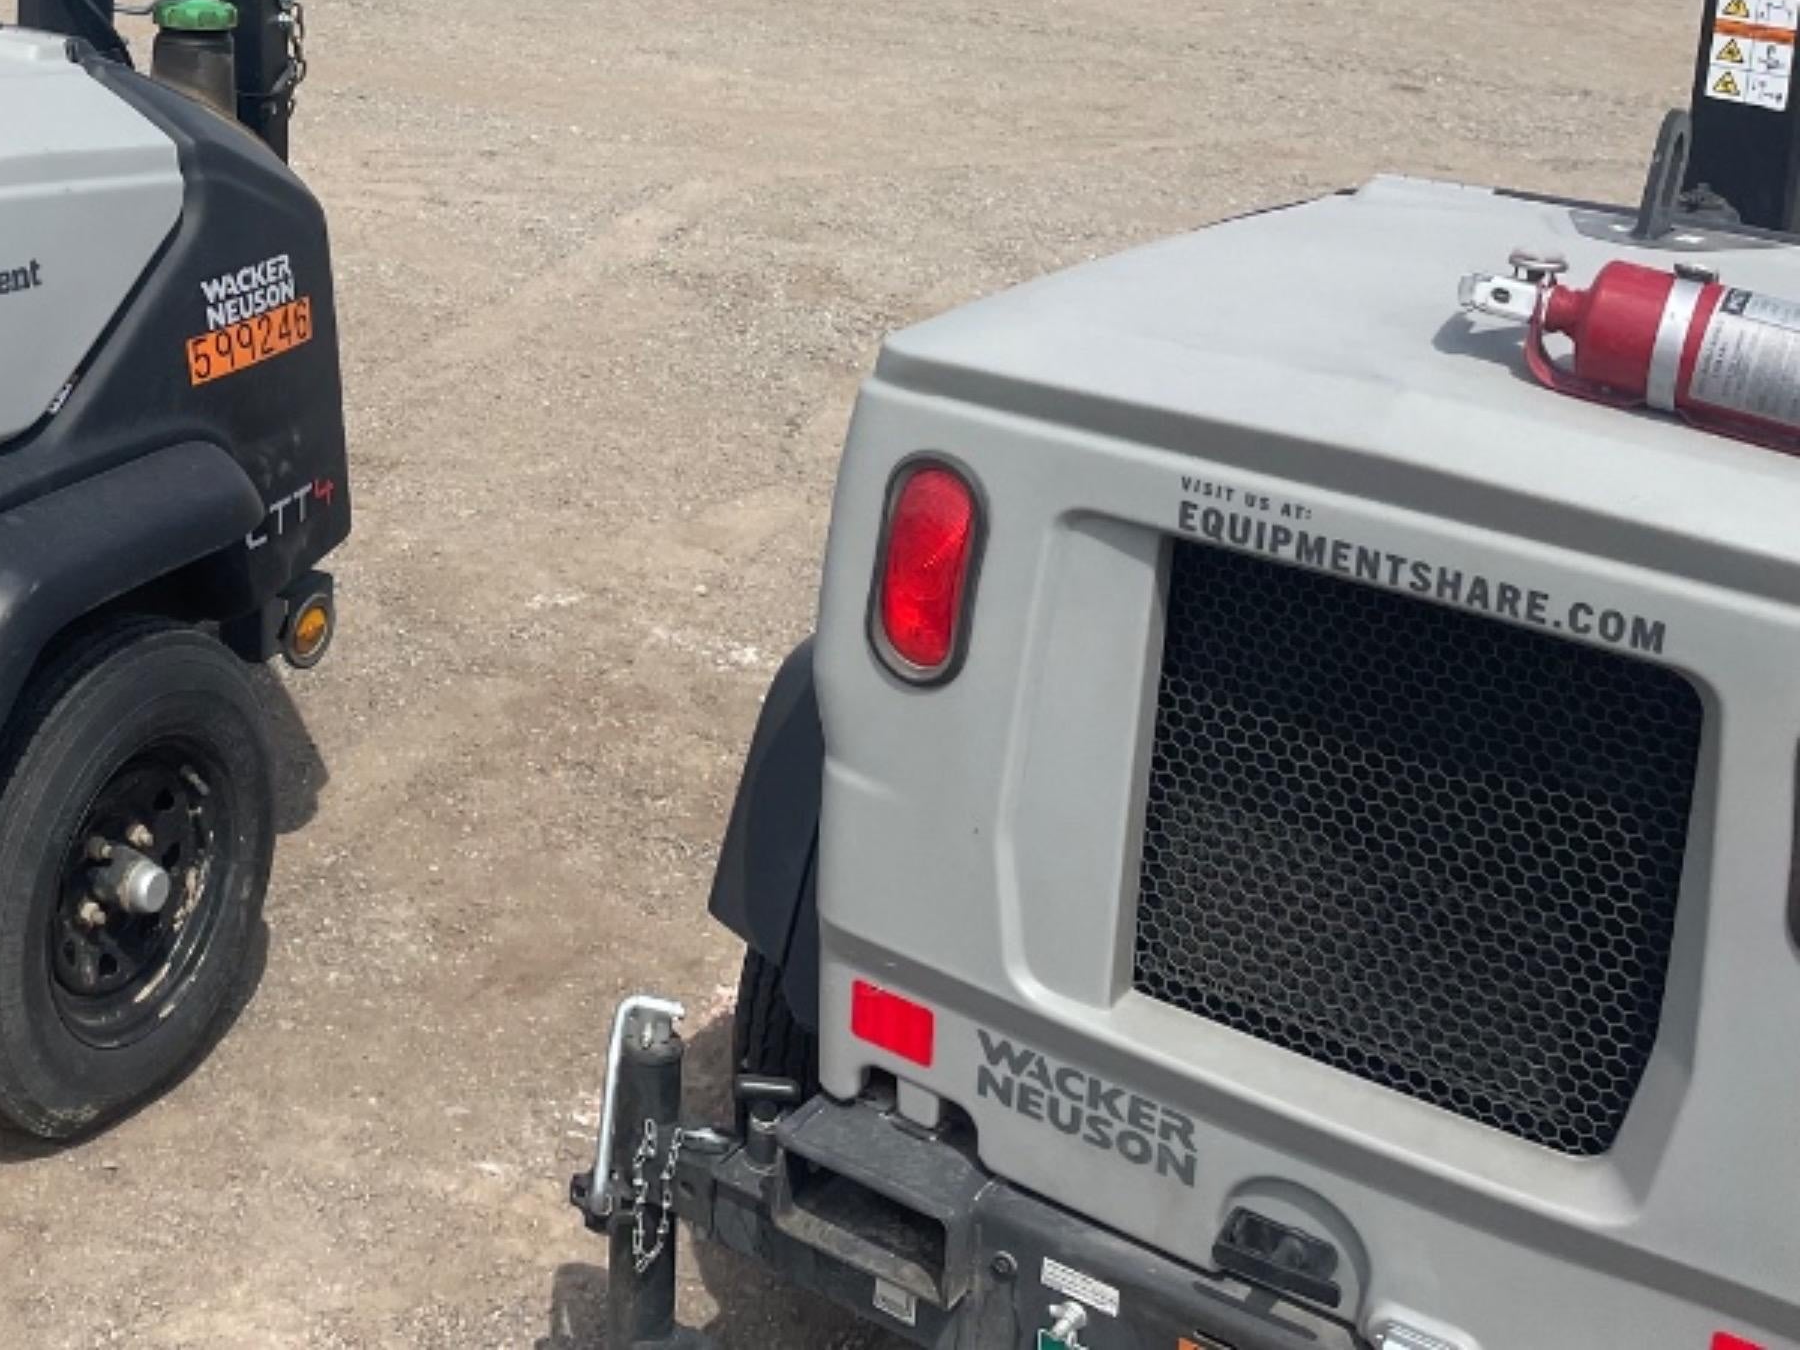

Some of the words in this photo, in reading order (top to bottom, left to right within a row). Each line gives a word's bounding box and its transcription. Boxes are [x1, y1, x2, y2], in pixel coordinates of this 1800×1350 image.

[200, 253, 294, 303] WACKER
[206, 276, 295, 330] NEUSON
[191, 298, 308, 379] 599246
[1180, 475, 1235, 503] VISIT
[1244, 491, 1271, 511] US
[1280, 500, 1313, 520] AT:
[1177, 500, 1666, 654] EQUIPMENTSHARE.COM
[977, 1028, 1198, 1153] WACKER
[977, 1064, 1198, 1189] NEUSON
